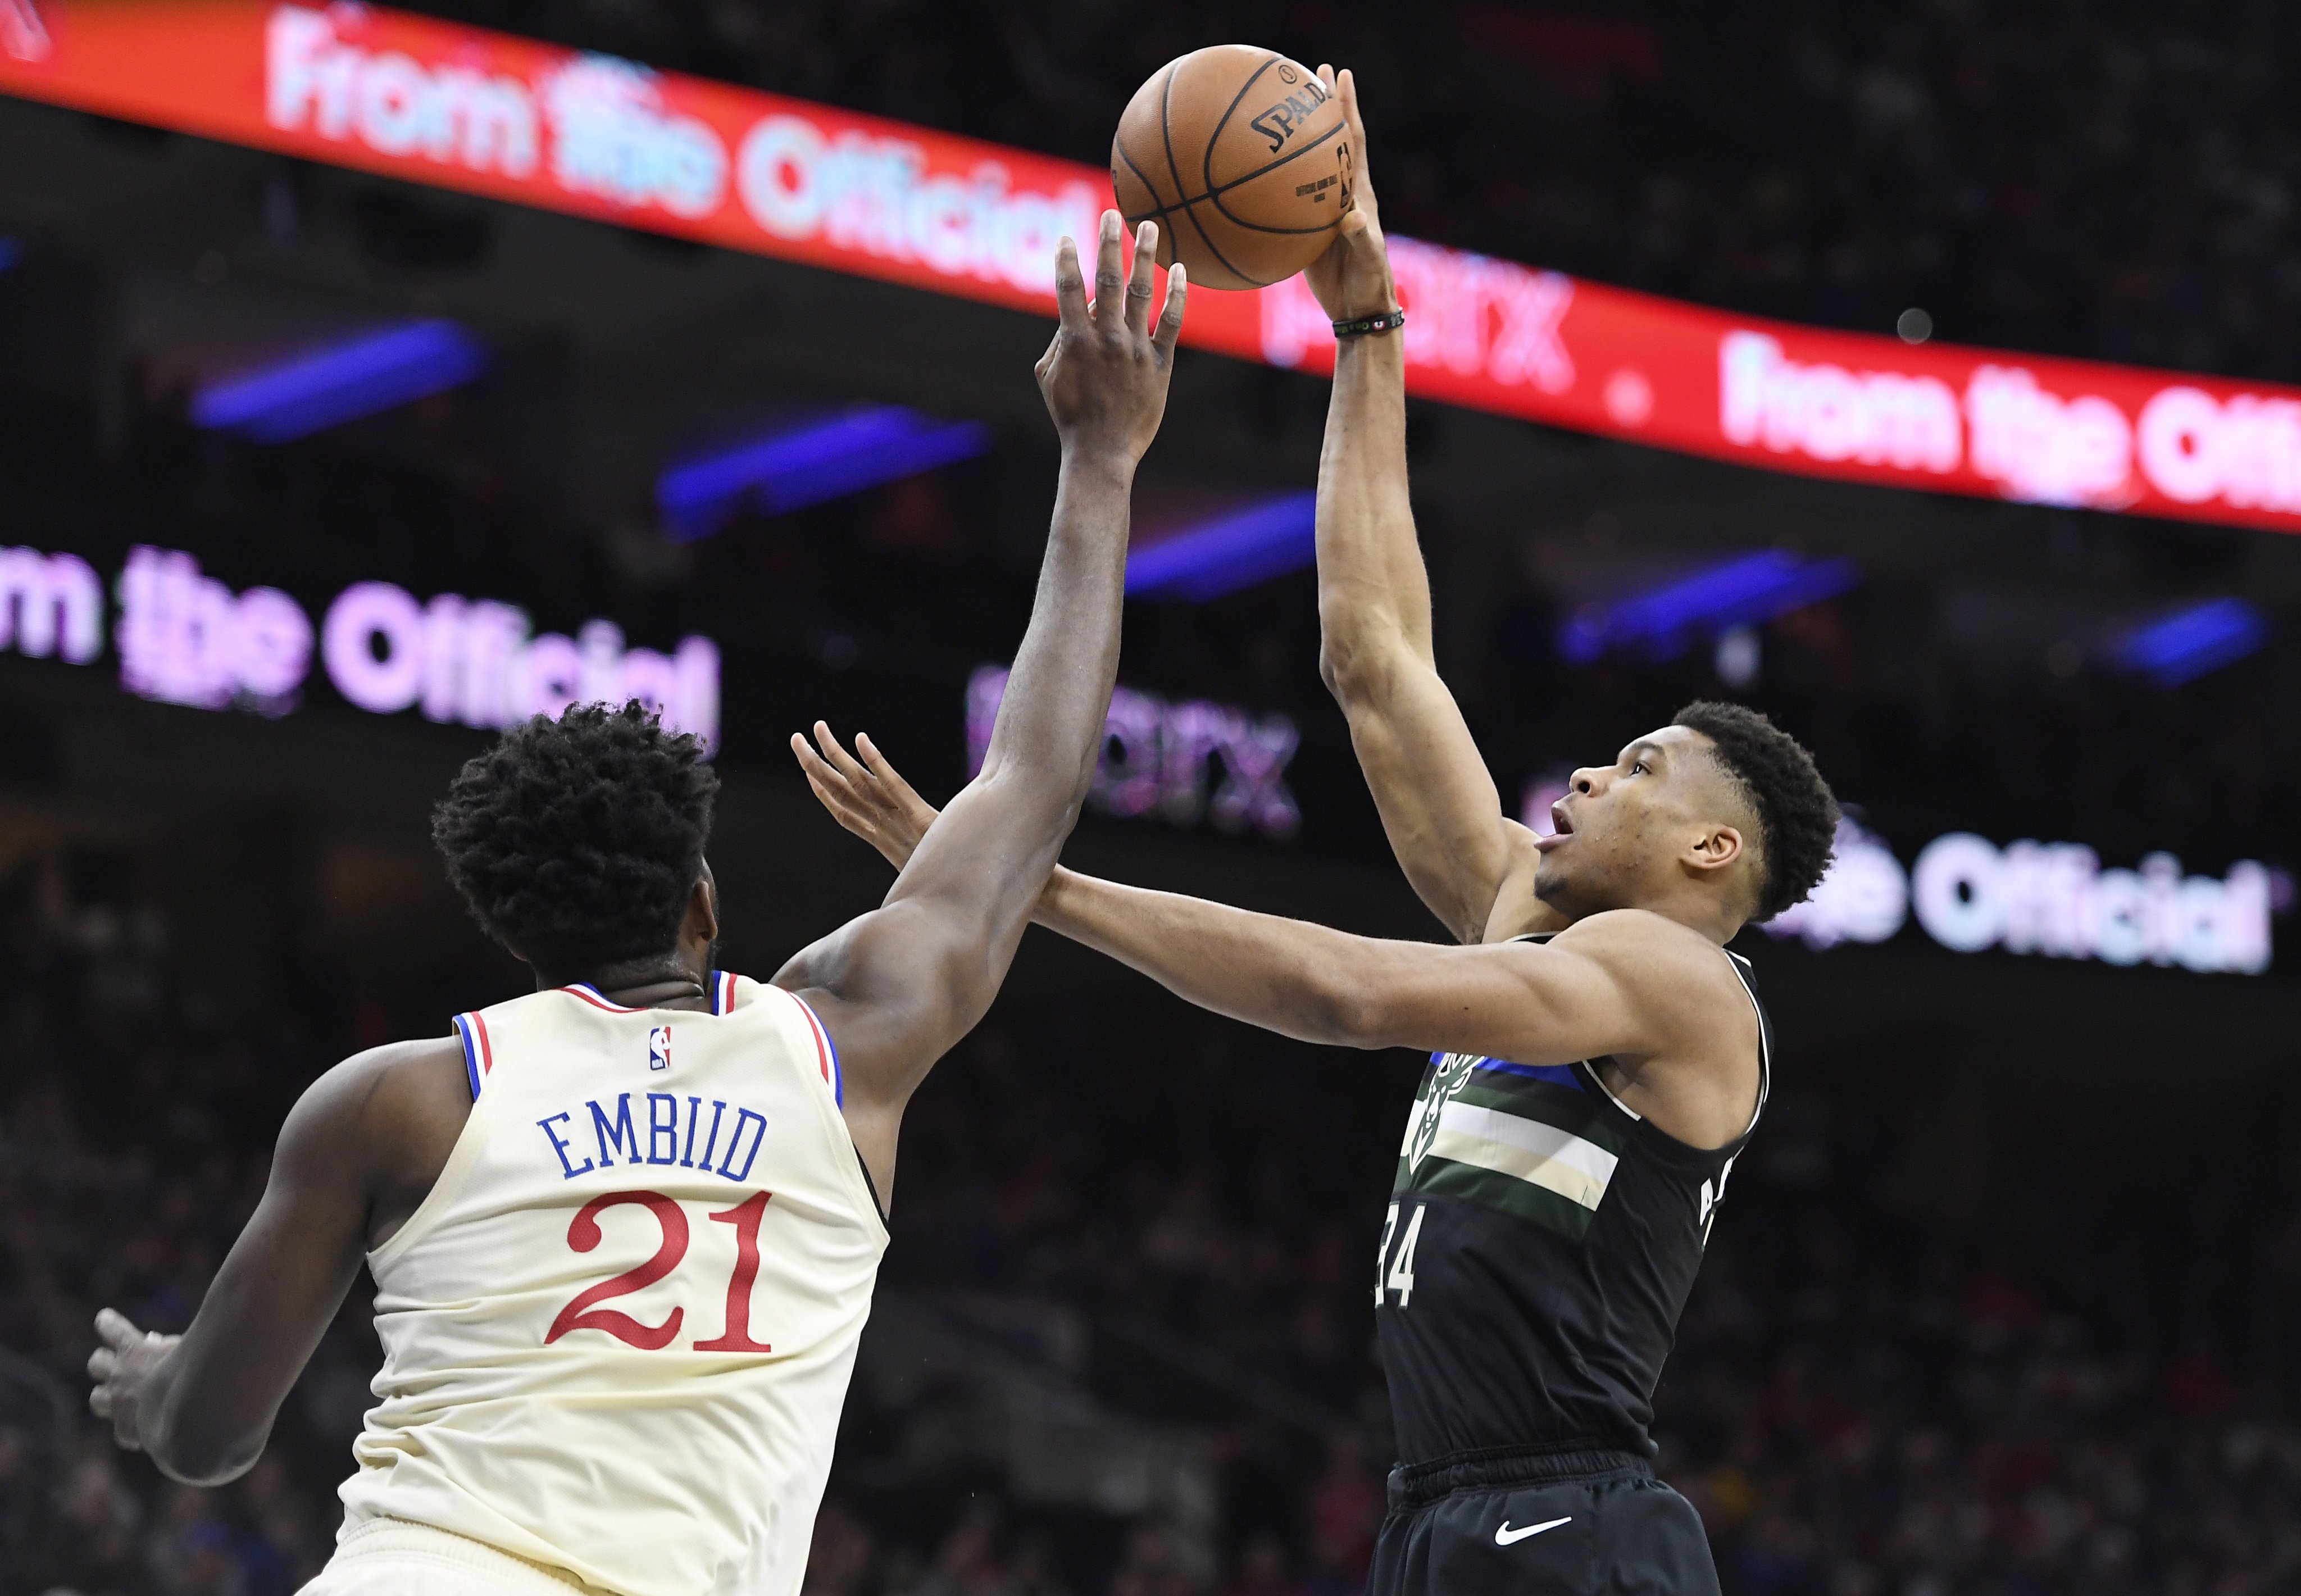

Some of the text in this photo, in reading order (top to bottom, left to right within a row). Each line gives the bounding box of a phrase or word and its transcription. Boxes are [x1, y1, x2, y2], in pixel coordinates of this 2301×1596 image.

[265, 3, 1102, 306] From the Official
[1250, 82, 1332, 154] SPALD
[1719, 330, 1961, 473] From
[1966, 364, 2135, 506] the
[118, 543, 315, 713] the
[320, 580, 719, 761] Official
[1912, 831, 2272, 976] Official
[536, 1093, 767, 1182] EMBIID
[544, 1190, 772, 1353] 21
